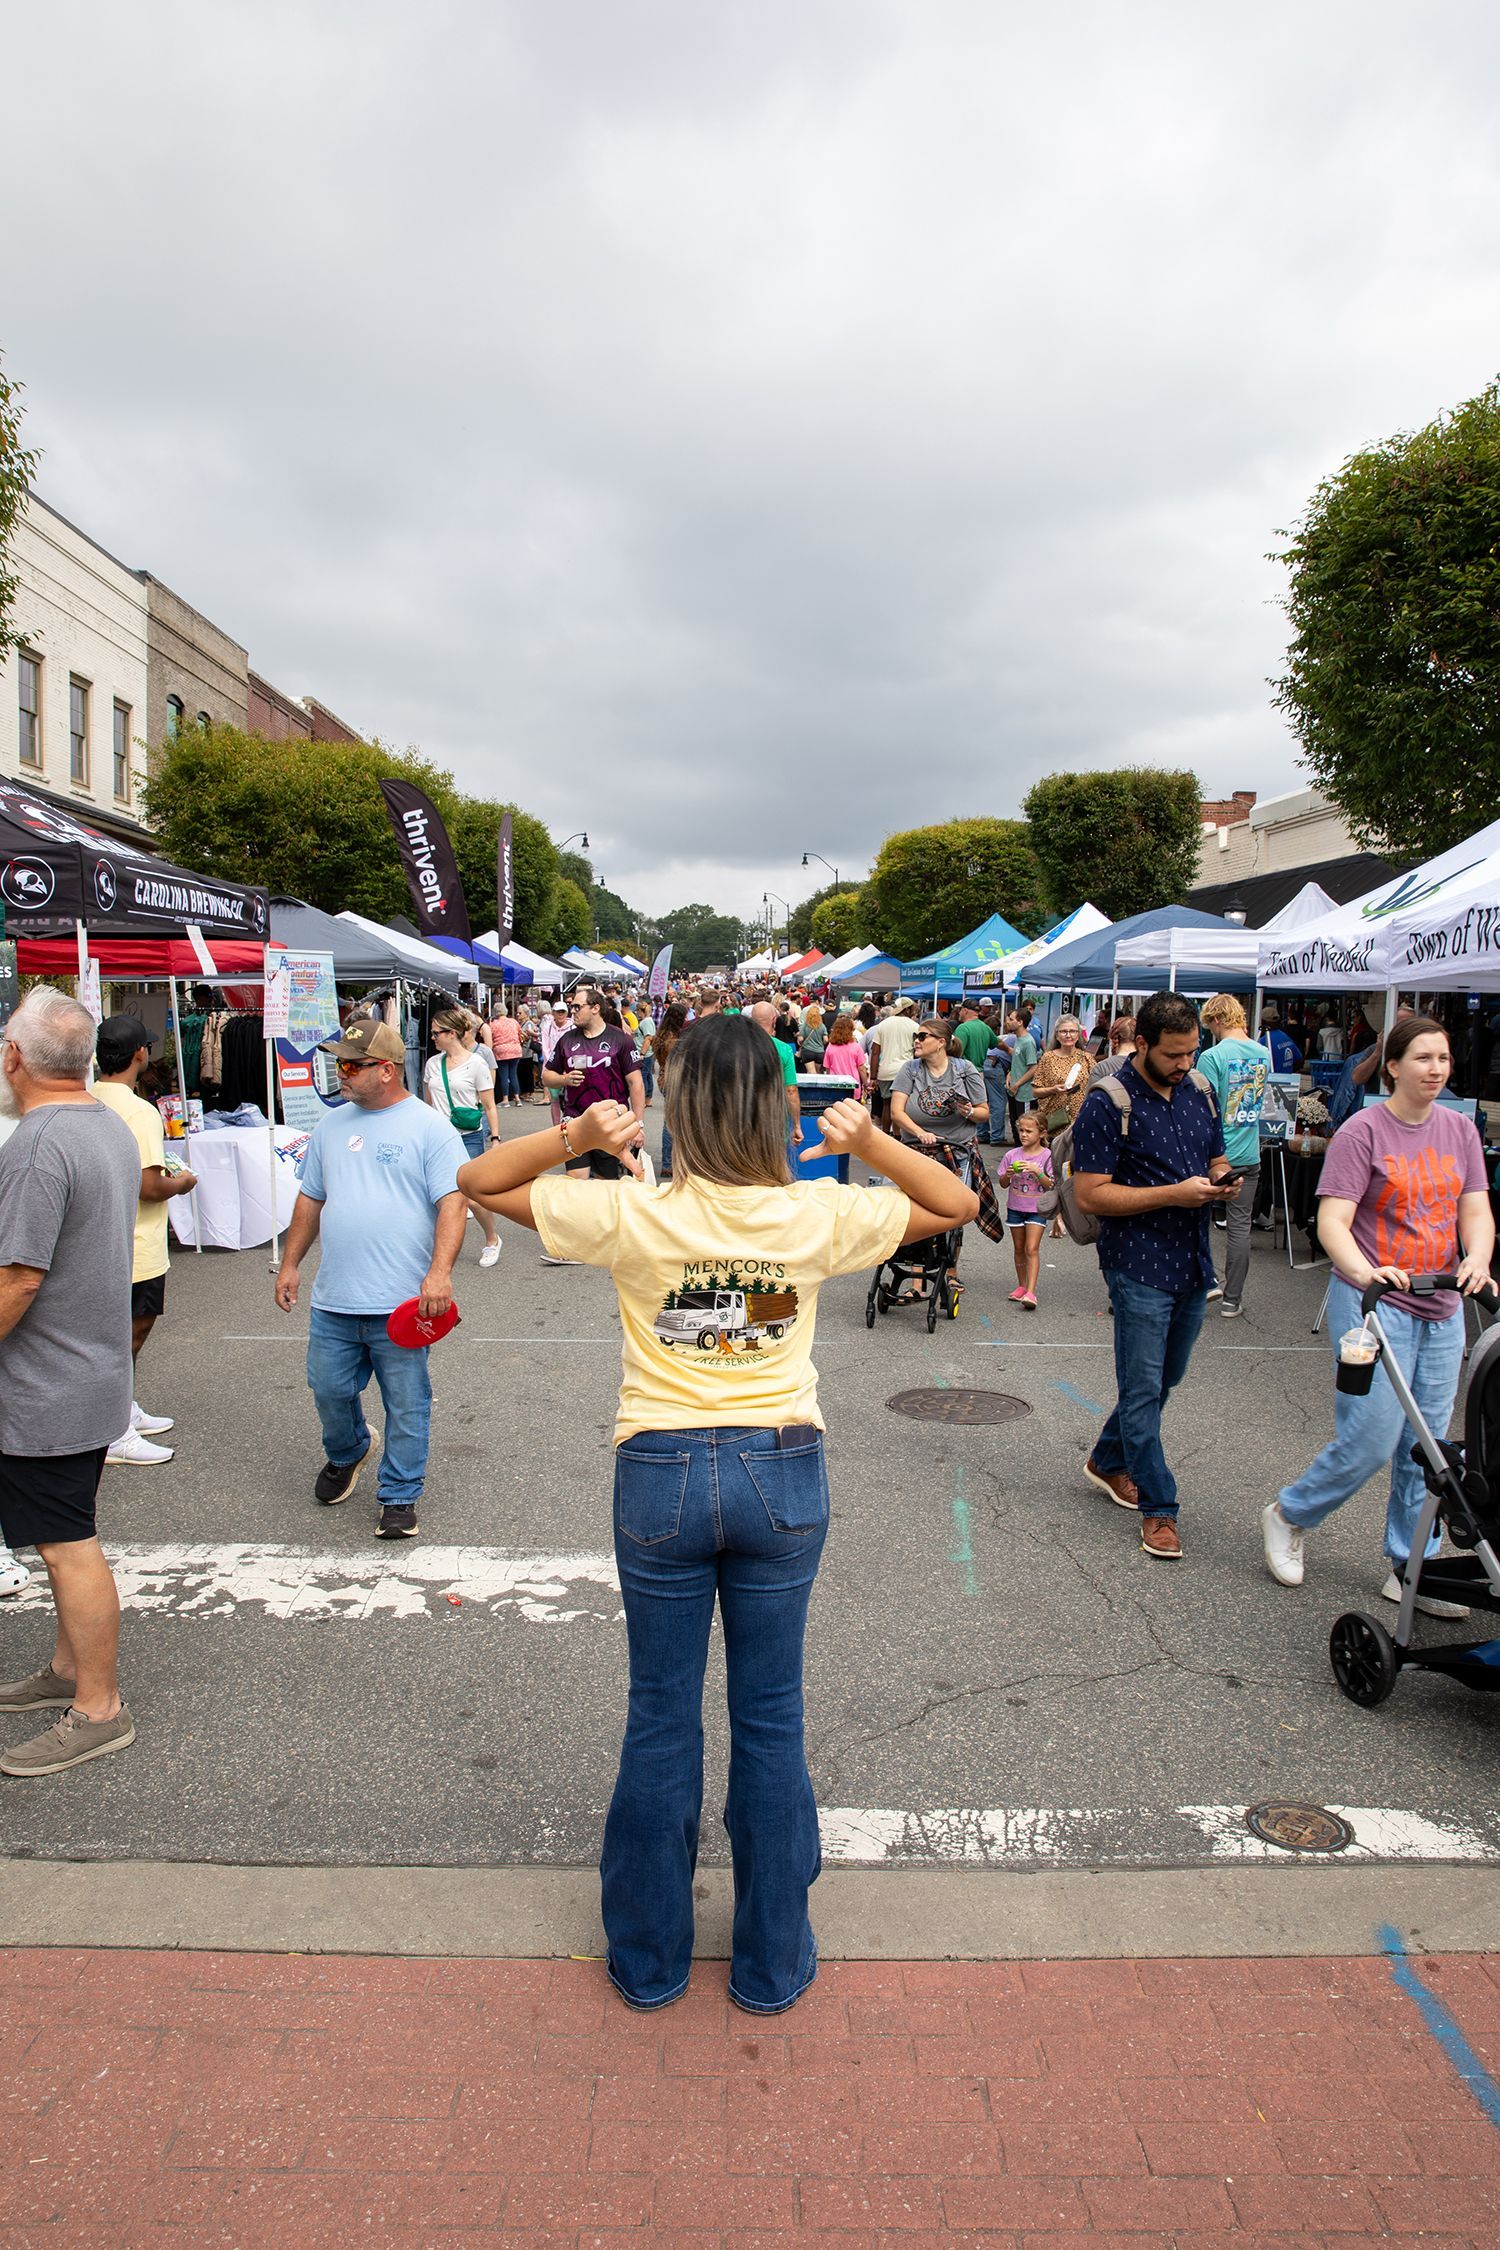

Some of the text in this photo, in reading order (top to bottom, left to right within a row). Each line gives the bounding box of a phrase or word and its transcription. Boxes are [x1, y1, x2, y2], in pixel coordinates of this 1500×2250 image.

[402, 808, 446, 914] thrivent
[134, 878, 190, 912] CAROLINA
[502, 838, 512, 930] thrivent
[1406, 930, 1448, 966] Town
[1452, 907, 1475, 957] of
[279, 955, 321, 970] American
[1265, 937, 1375, 976] Town of Wendell
[290, 969, 319, 979] omfort
[1288, 1126, 1294, 1135] 5
[683, 1259, 786, 1279] MENCOR'S
[724, 1353, 770, 1367] SERVICE
